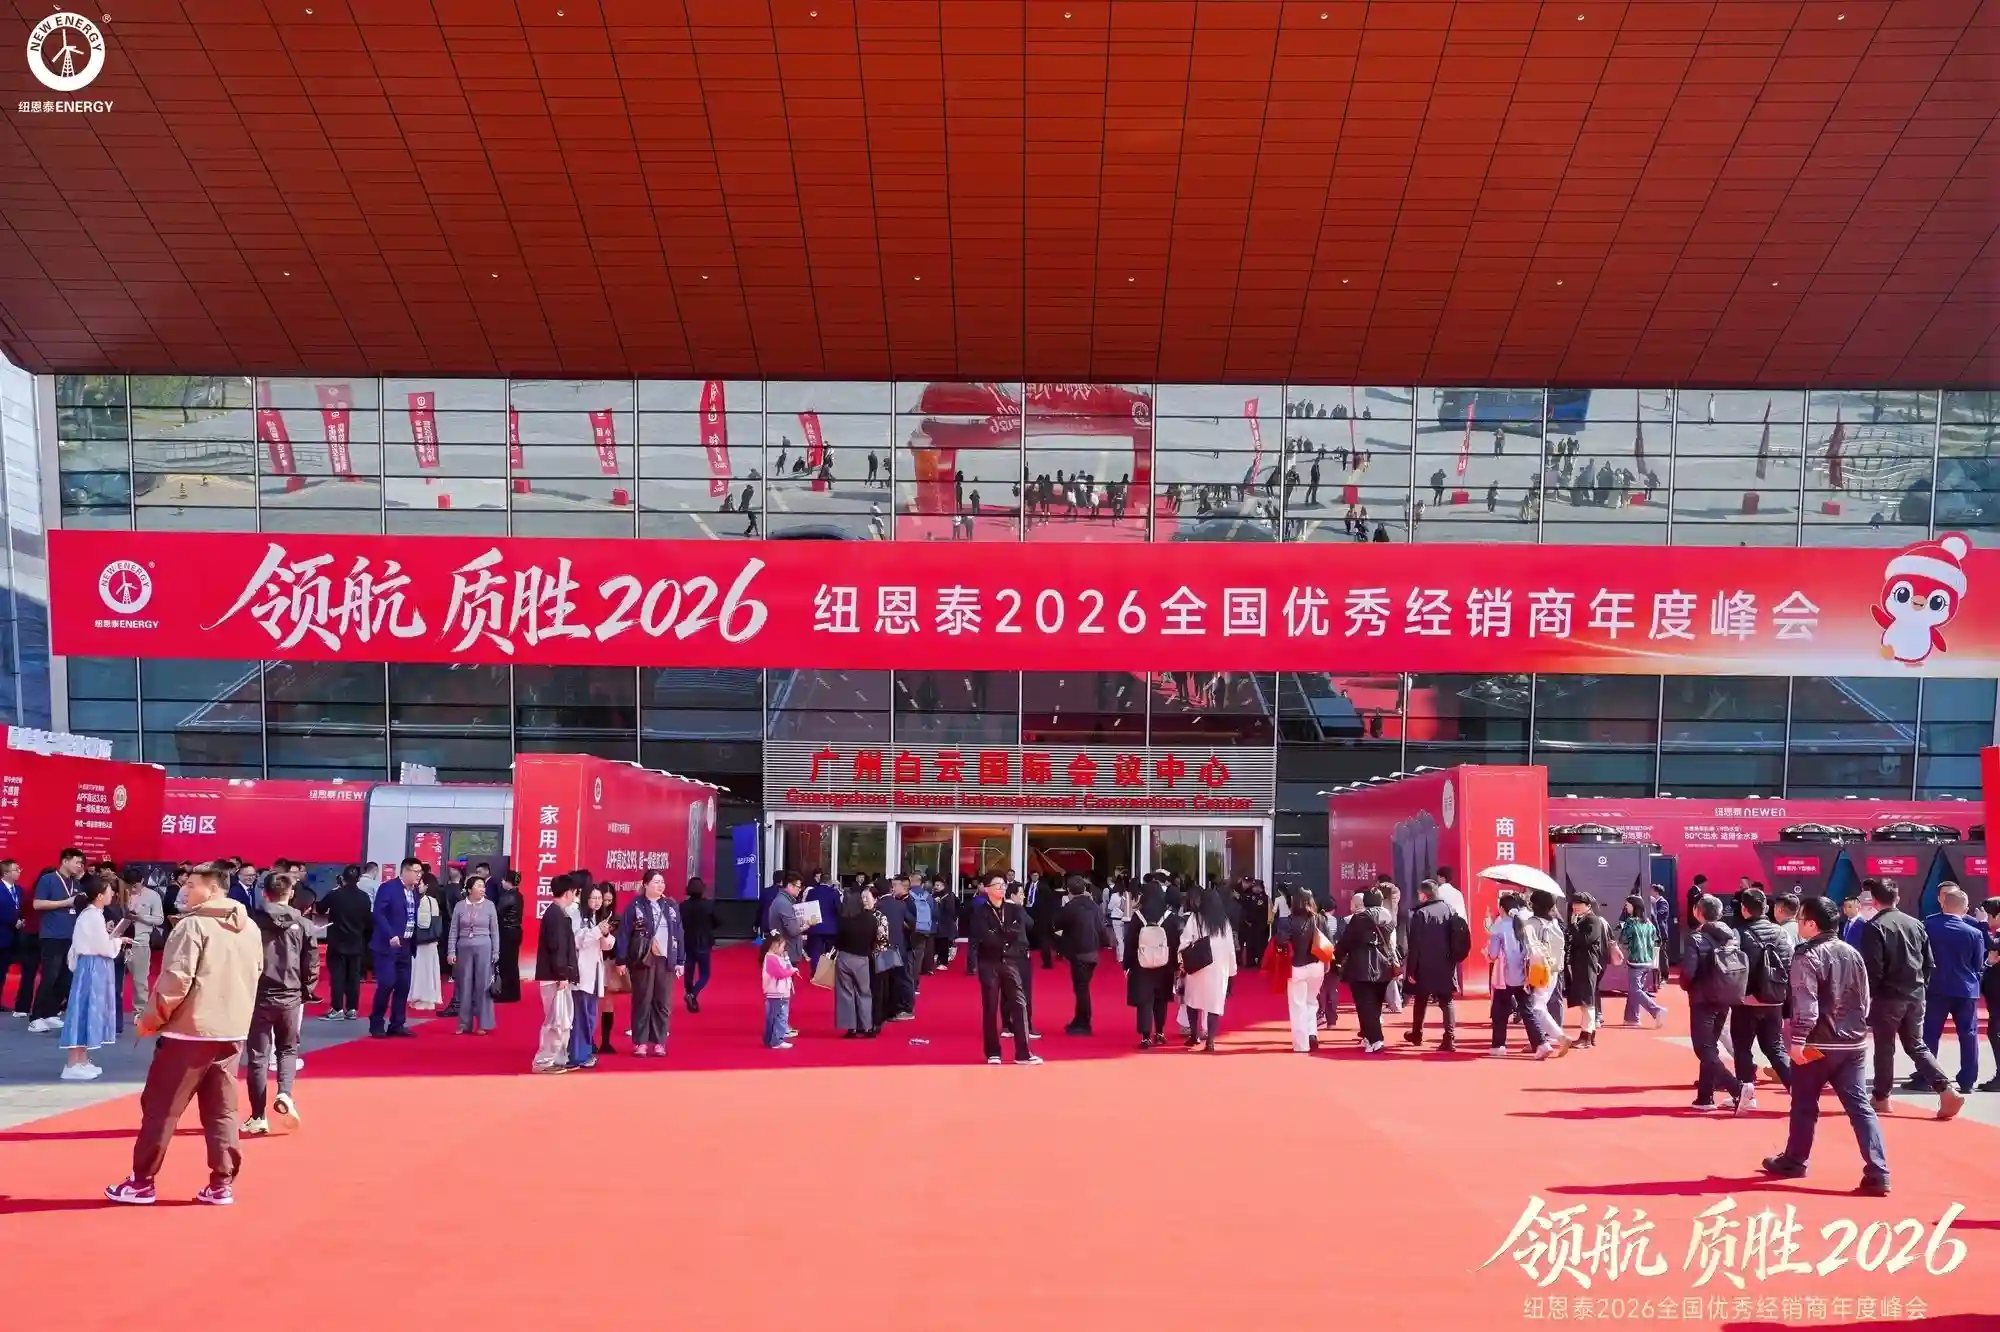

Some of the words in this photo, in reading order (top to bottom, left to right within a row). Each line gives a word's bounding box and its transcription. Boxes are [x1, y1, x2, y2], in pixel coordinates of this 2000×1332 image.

[101, 566, 116, 588] NEW
[117, 562, 150, 588] ENERGY
[200, 542, 427, 652] 领航
[813, 583, 1820, 642] 纽恩泰2026全国优秀经销商年度峰会
[809, 745, 1231, 788] 广州白云国际会议中心
[337, 790, 367, 800] NEW
[785, 788, 889, 808] Guangzhou
[894, 790, 954, 808] Baiyun
[961, 792, 1076, 808] International
[1084, 792, 1186, 809] Convention
[1193, 792, 1253, 809] Center
